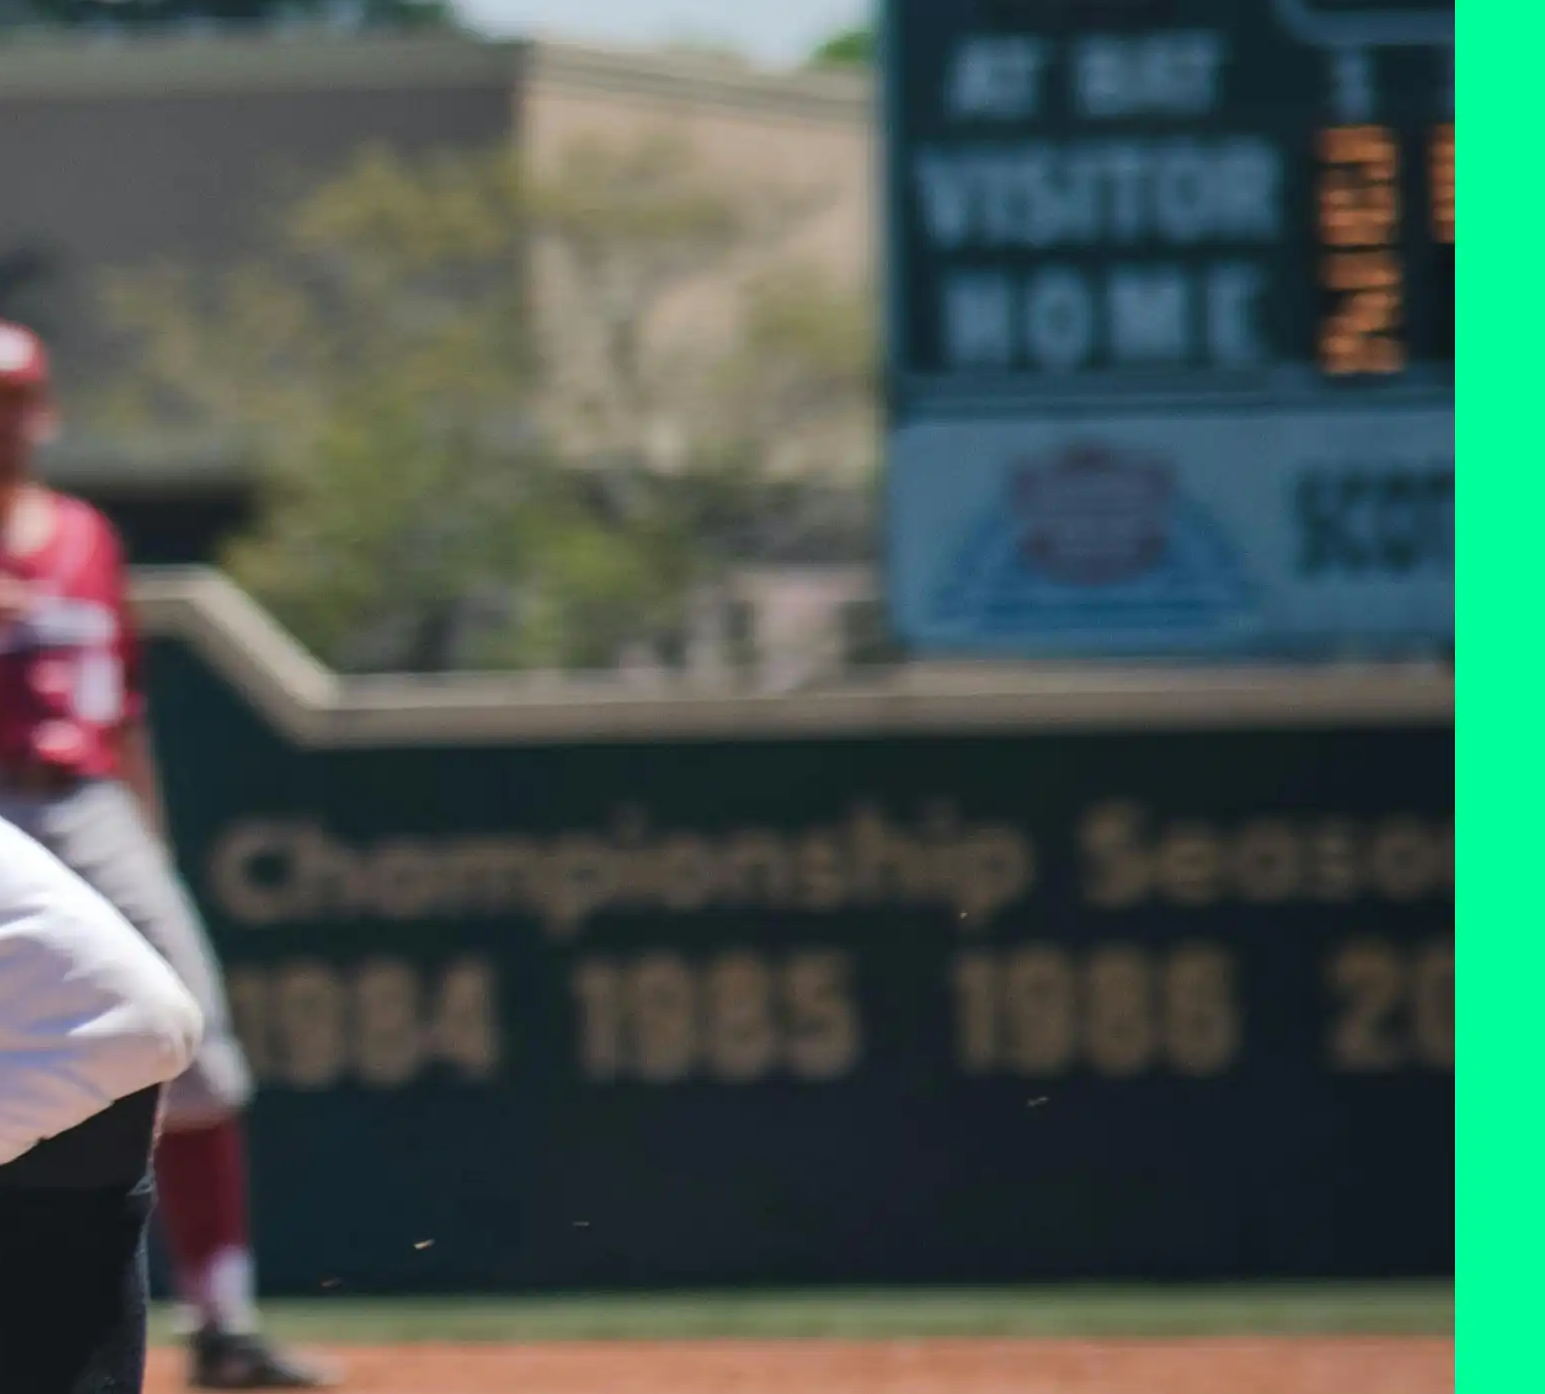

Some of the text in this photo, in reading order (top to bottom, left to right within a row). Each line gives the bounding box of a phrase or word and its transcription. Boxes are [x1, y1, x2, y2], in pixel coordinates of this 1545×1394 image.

[915, 135, 1281, 249] VISITOR
[946, 261, 1269, 370] HOME
[210, 799, 1455, 939] Championship Seaso
[575, 949, 856, 1083] 1985
[952, 942, 1239, 1076] 1986
